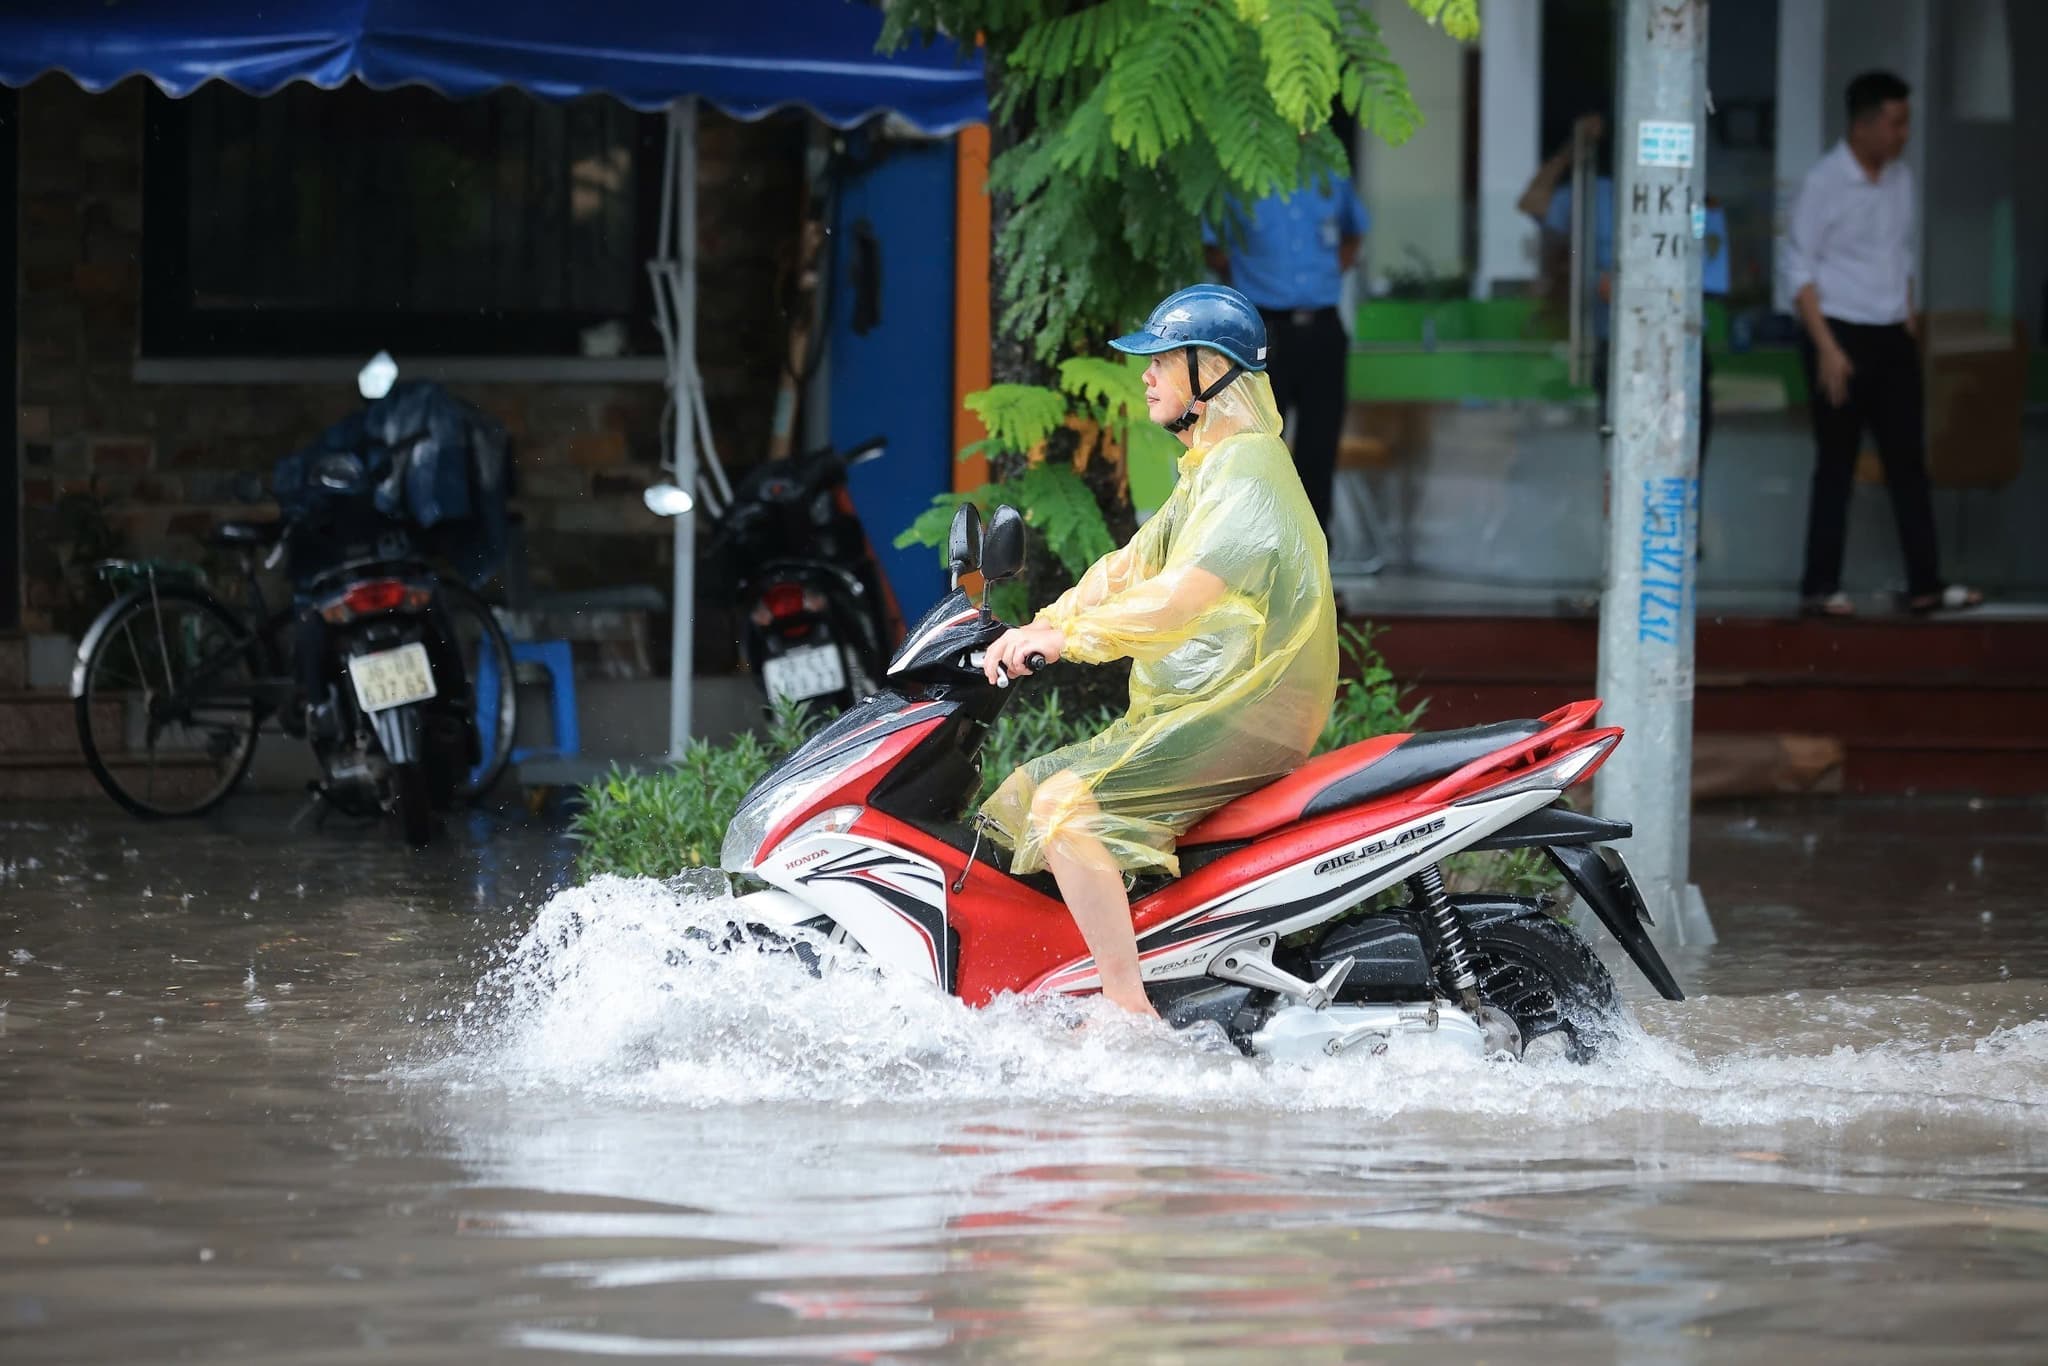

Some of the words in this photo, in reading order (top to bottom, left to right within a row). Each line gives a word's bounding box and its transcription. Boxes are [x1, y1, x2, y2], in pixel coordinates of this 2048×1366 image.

[785, 848, 830, 870] HONDA
[1314, 851, 1356, 876] AIR
[1360, 816, 1446, 858] BLADE
